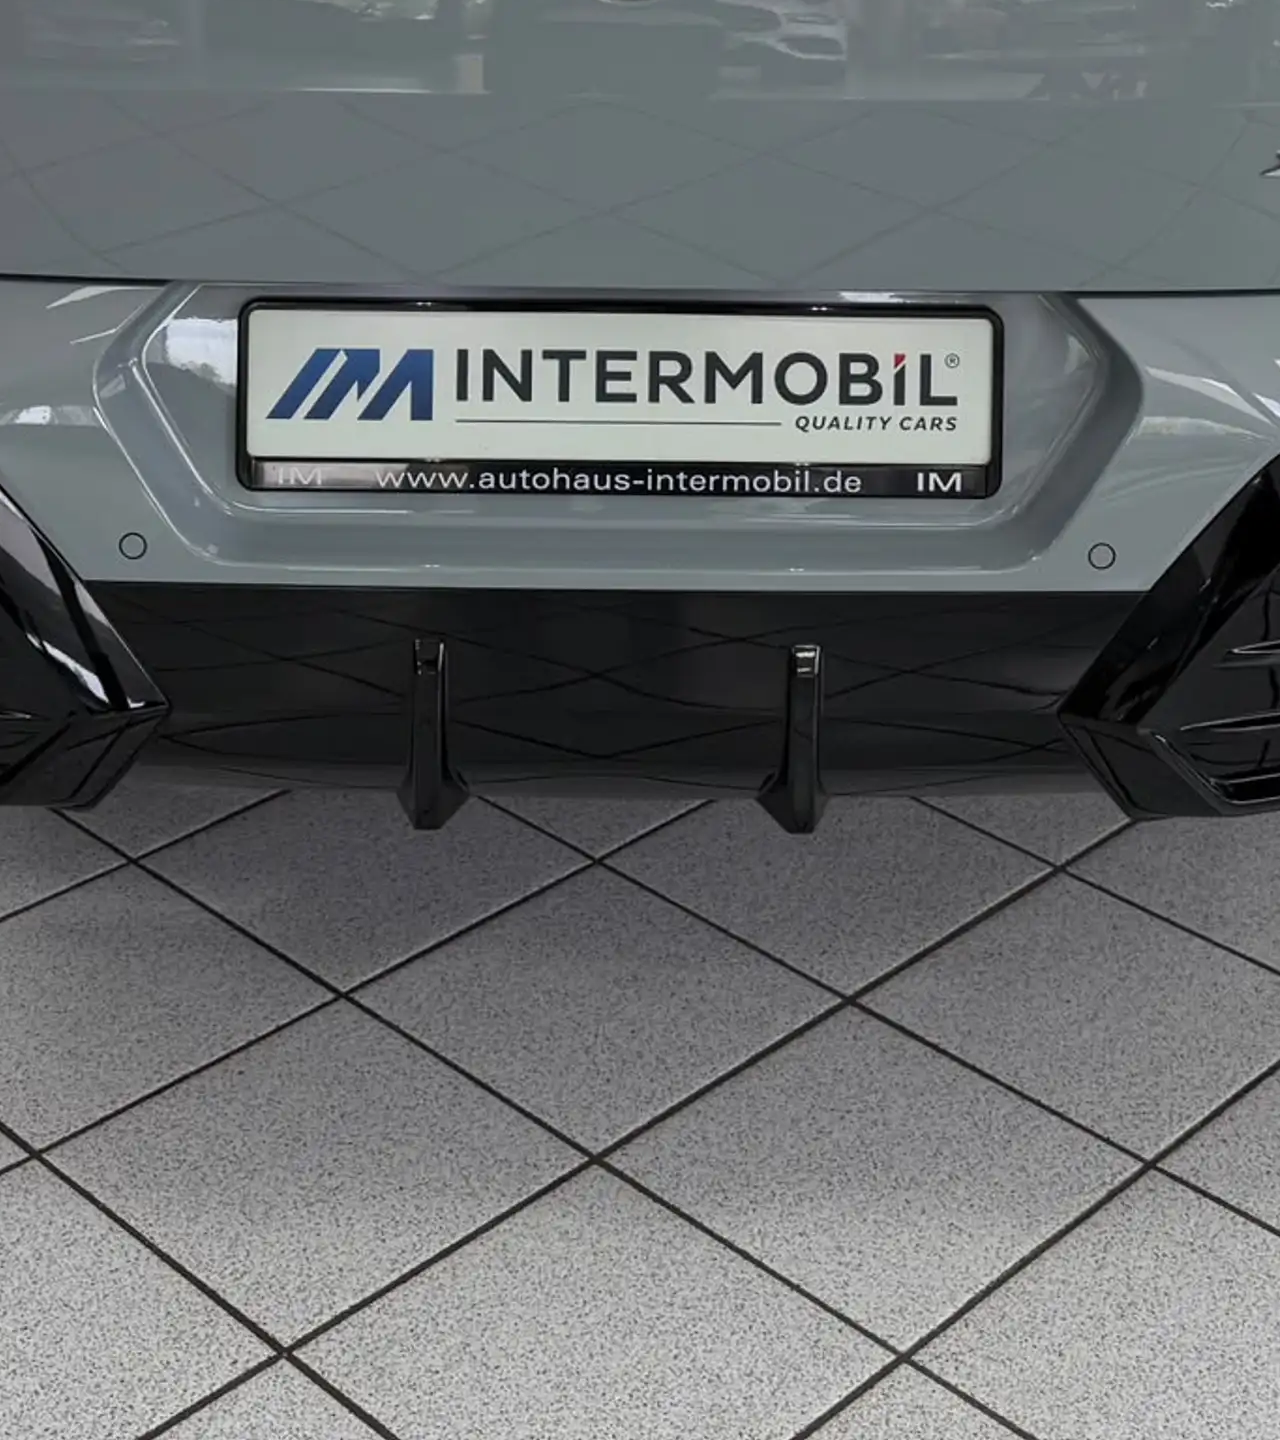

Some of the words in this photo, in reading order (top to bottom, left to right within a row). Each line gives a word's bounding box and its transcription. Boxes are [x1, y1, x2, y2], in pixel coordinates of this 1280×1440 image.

[794, 415, 893, 433] QUALITY
[898, 416, 958, 432] CARS
[375, 466, 862, 494] www.autohaus-intermobil.de
[916, 471, 962, 493] IM
